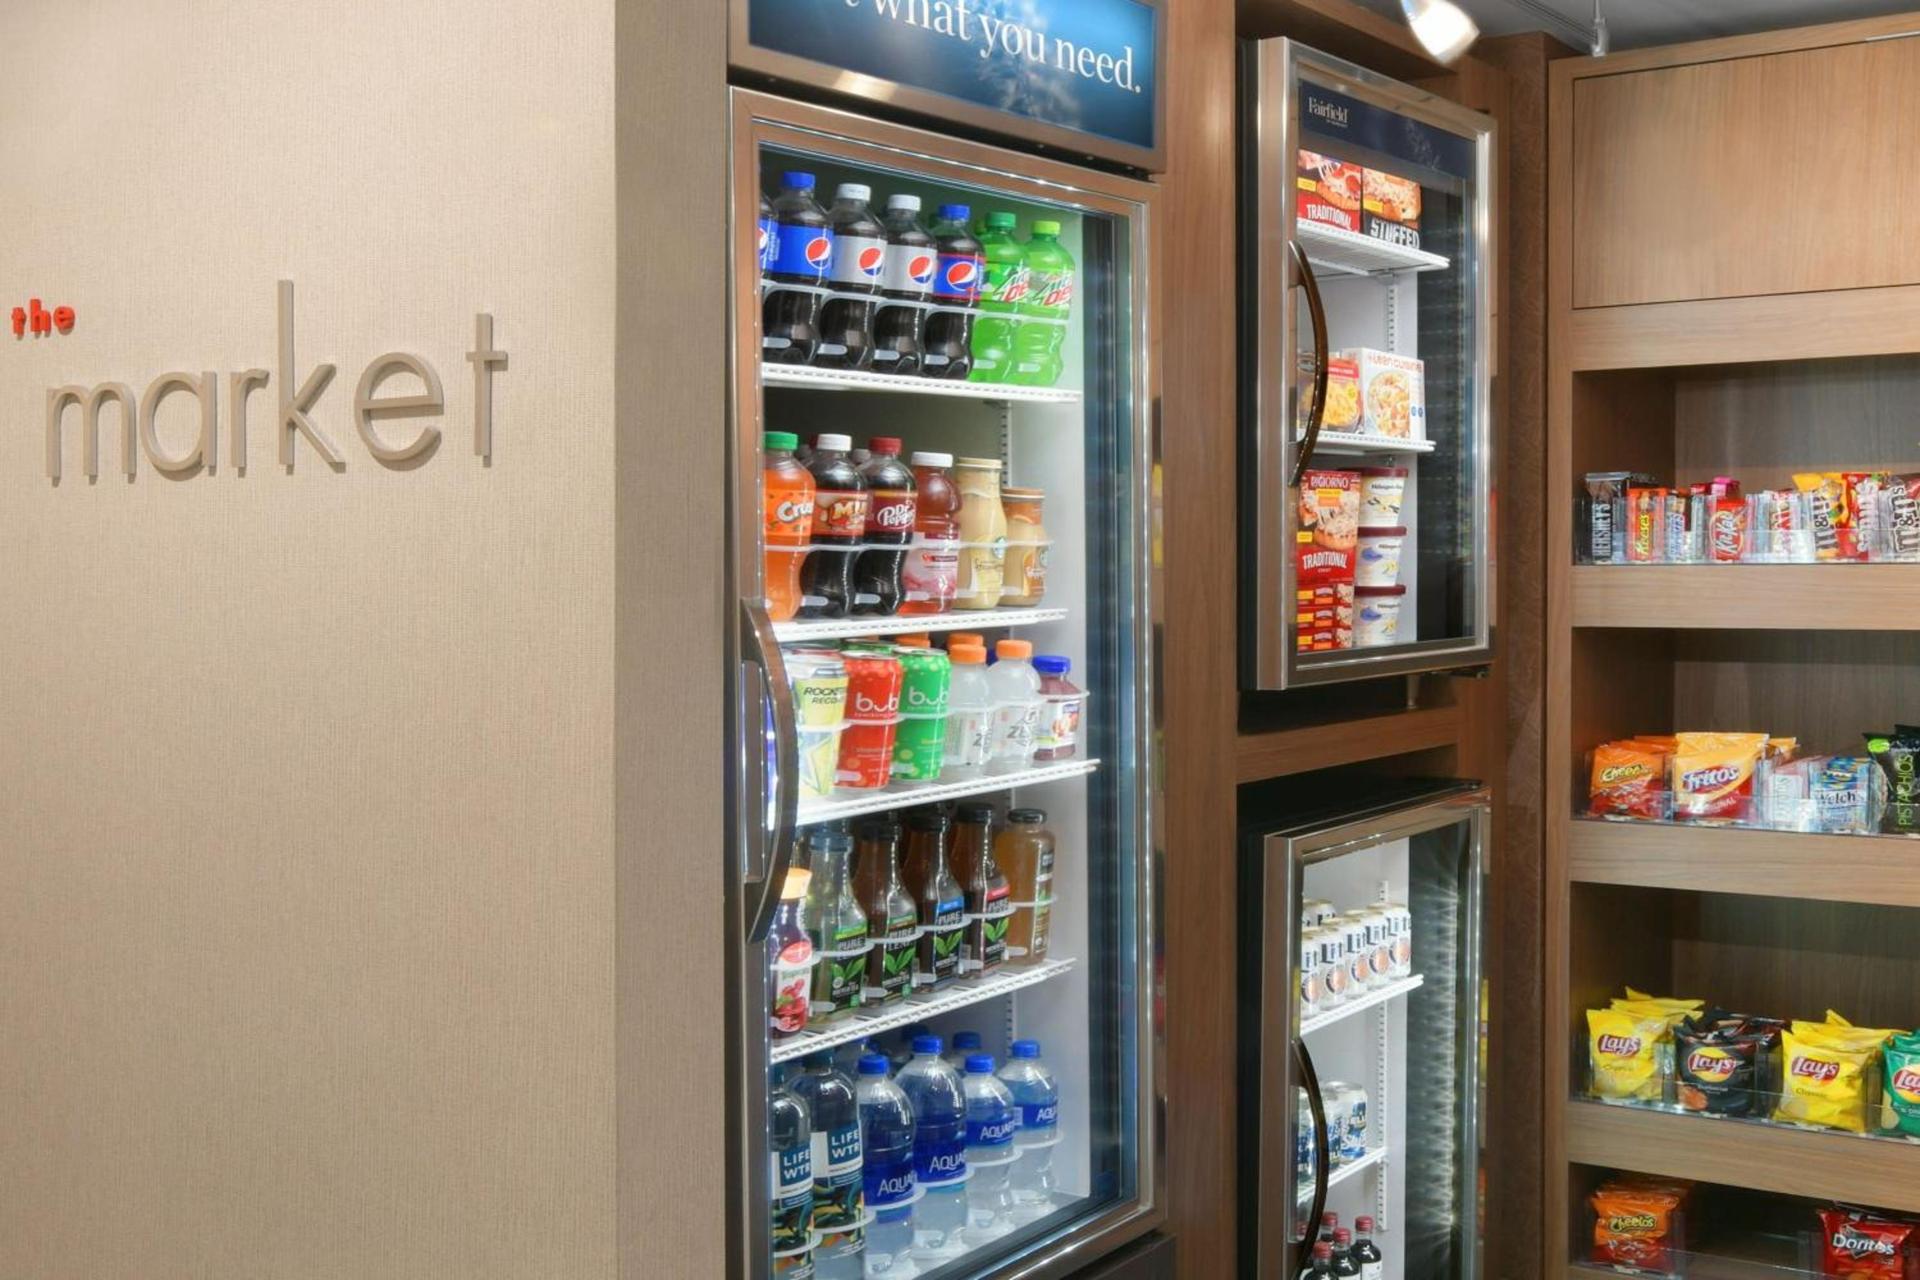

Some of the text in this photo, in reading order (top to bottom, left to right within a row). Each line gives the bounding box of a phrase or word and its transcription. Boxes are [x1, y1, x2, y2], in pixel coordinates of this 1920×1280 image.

[875, 0, 1142, 94] what you need.
[1308, 96, 1349, 124] Fairfield
[11, 298, 76, 337] the
[46, 280, 509, 484] market
[1898, 753, 1914, 825] PISTACHIOS
[832, 1128, 859, 1146] LIFE
[1833, 1233, 1894, 1255] Doritos
